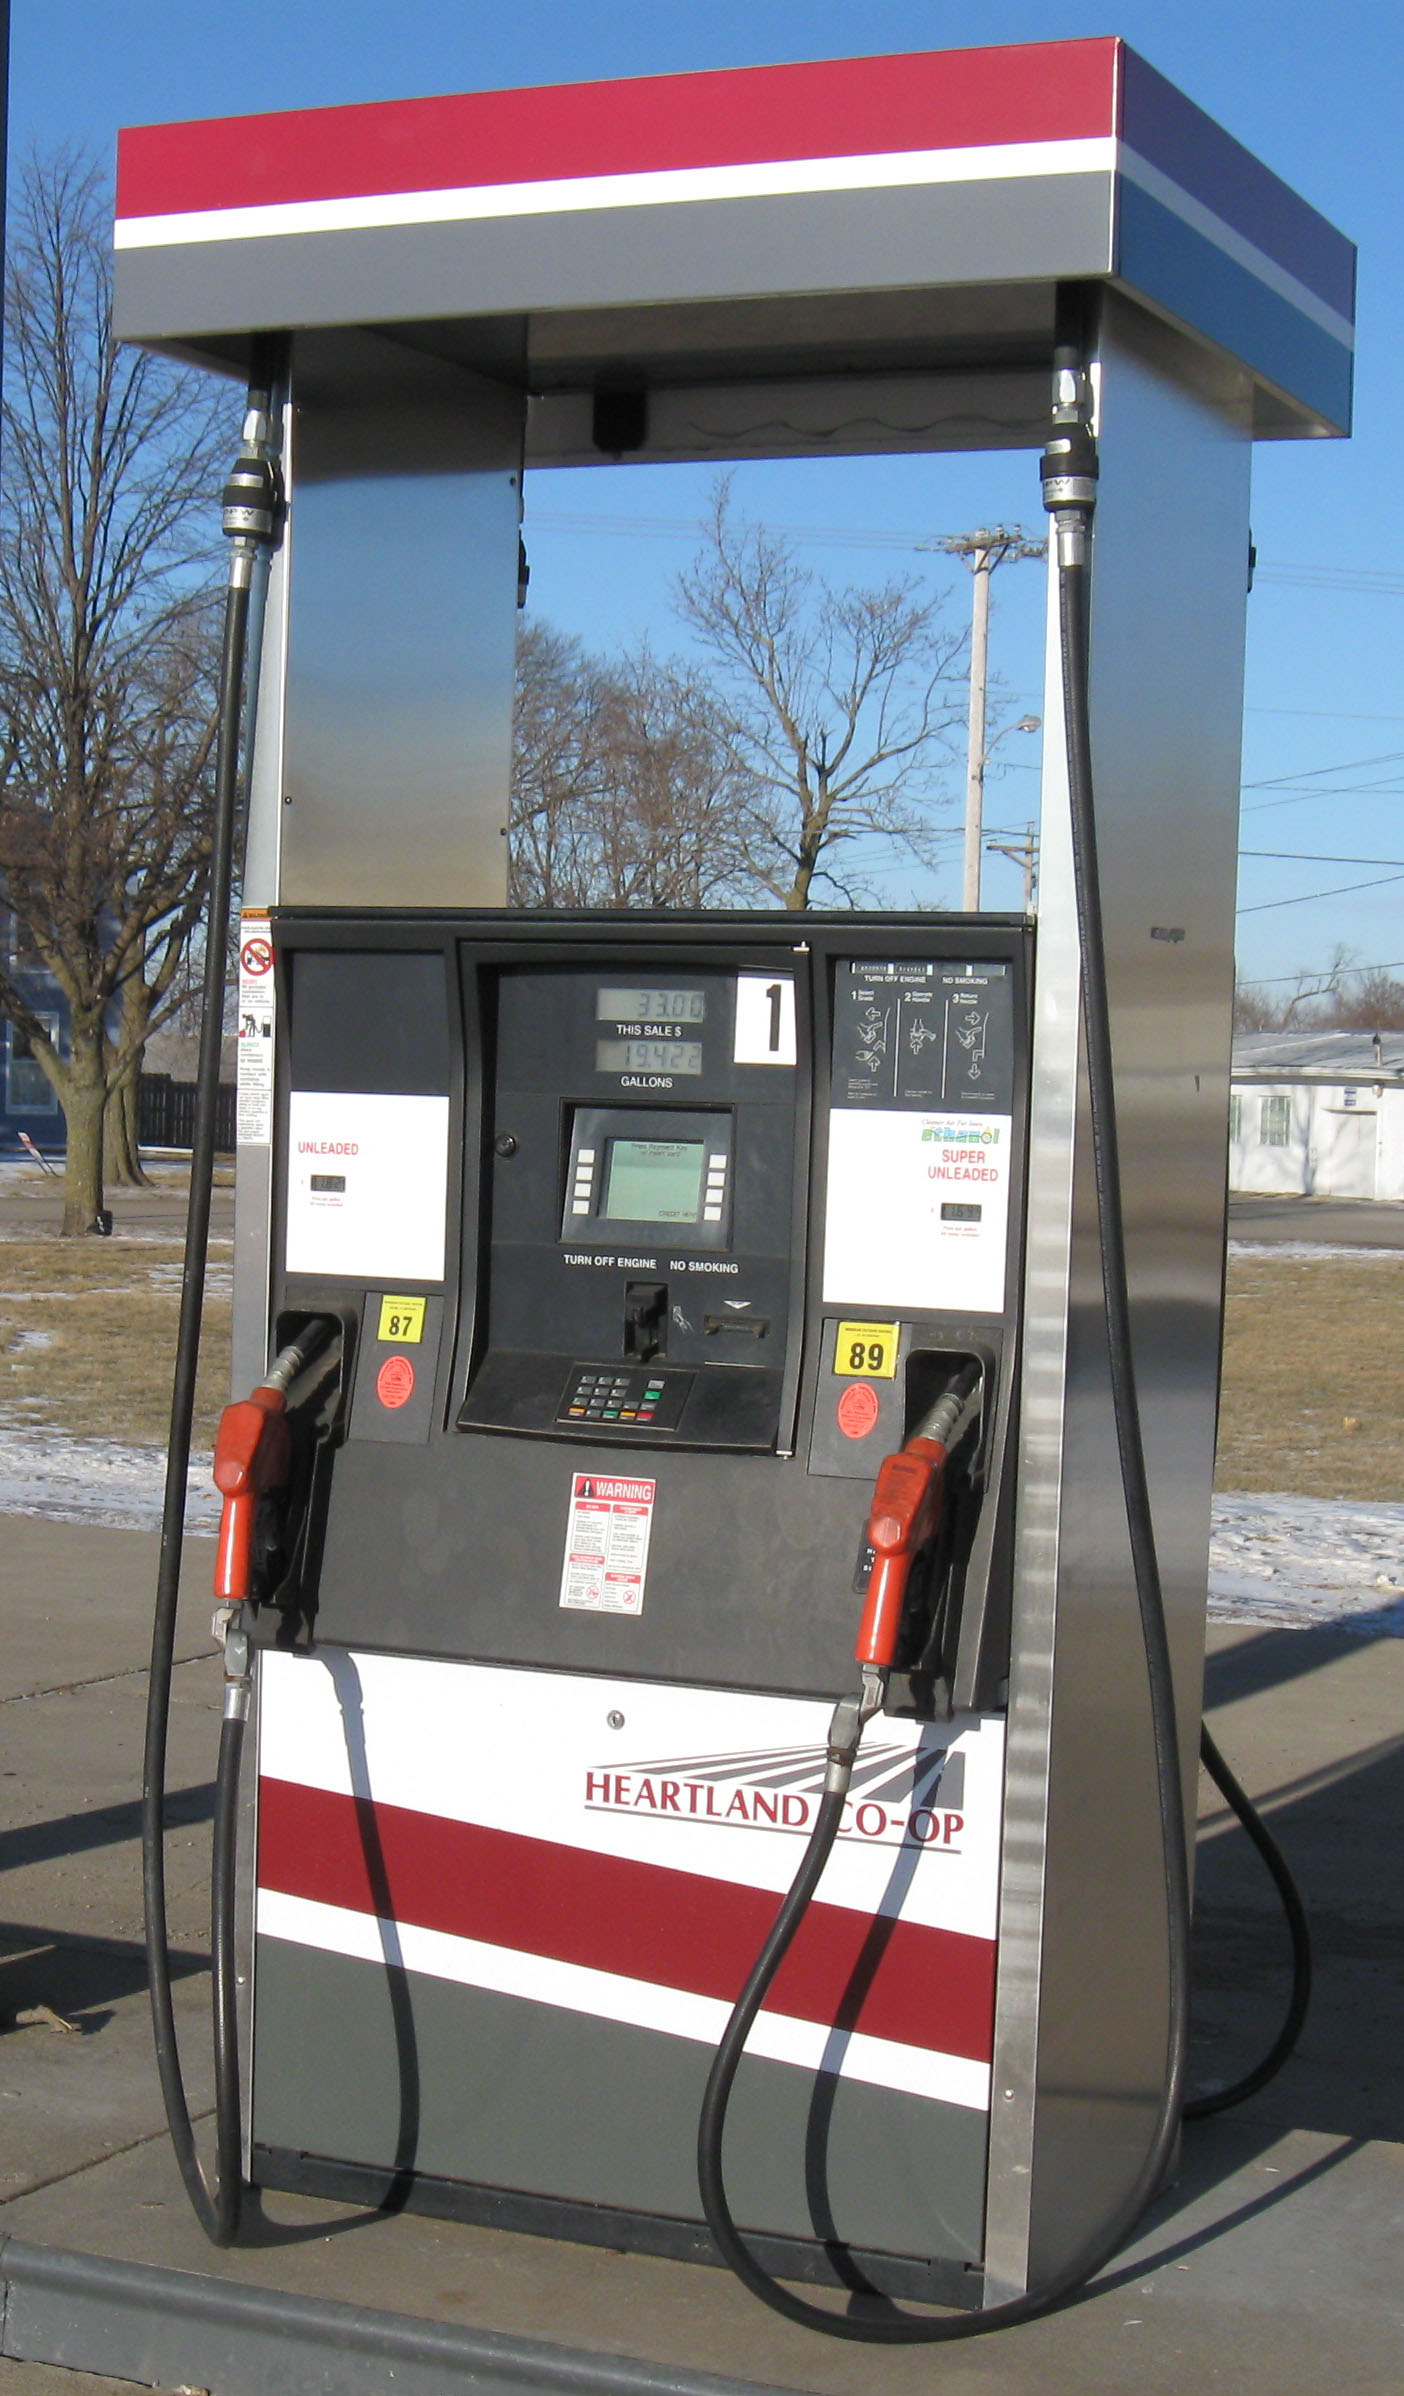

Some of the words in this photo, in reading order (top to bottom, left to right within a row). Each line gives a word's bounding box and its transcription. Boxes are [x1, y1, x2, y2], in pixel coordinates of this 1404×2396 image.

[864, 975, 884, 983] TURN
[884, 975, 899, 984] OFF
[942, 976, 954, 985] NO
[954, 977, 989, 986] SMOKING
[850, 990, 858, 1001] 1
[904, 991, 912, 1002] 2
[952, 993, 960, 1004] 3
[766, 983, 783, 1052] 1
[616, 1024, 642, 1036] THIS
[643, 1025, 673, 1037] SALE
[674, 1026, 683, 1038] $
[620, 1075, 673, 1089] GALLONS
[921, 1126, 1001, 1145] ethanol
[298, 1141, 360, 1156] UNLEADED
[941, 1149, 986, 1164] SUPER
[927, 1166, 999, 1182] UNLEADED
[563, 1254, 592, 1266] TURN
[594, 1256, 616, 1267] OFF
[617, 1257, 657, 1270] ENGINE
[669, 1260, 686, 1271] NO
[688, 1261, 739, 1274] SMOKING
[388, 1315, 413, 1337] 87
[849, 1342, 884, 1371] 89
[595, 1480, 652, 1501] WARNING
[585, 1771, 810, 1827] HEARTLAND
